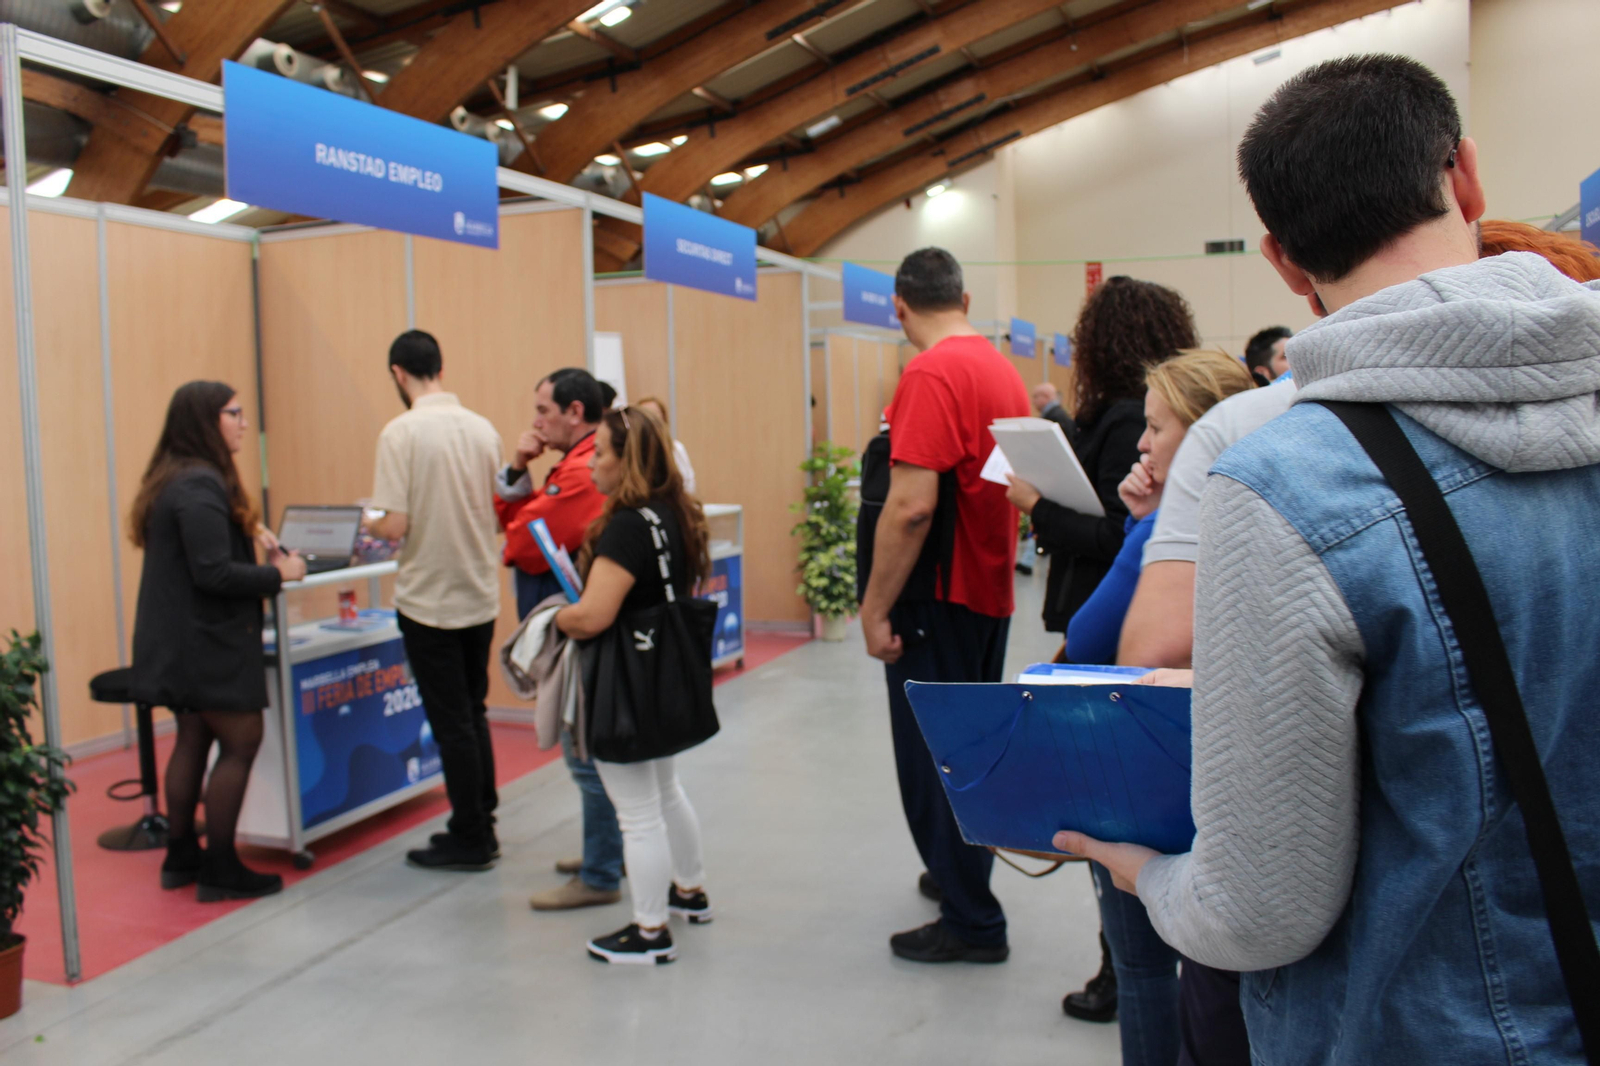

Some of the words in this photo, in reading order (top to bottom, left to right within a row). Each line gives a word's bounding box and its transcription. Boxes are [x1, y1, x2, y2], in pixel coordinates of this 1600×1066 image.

[315, 142, 386, 179] RANSTAD
[388, 161, 443, 193] EMPLEO
[317, 681, 355, 711] FERIA
[356, 673, 374, 699] DE
